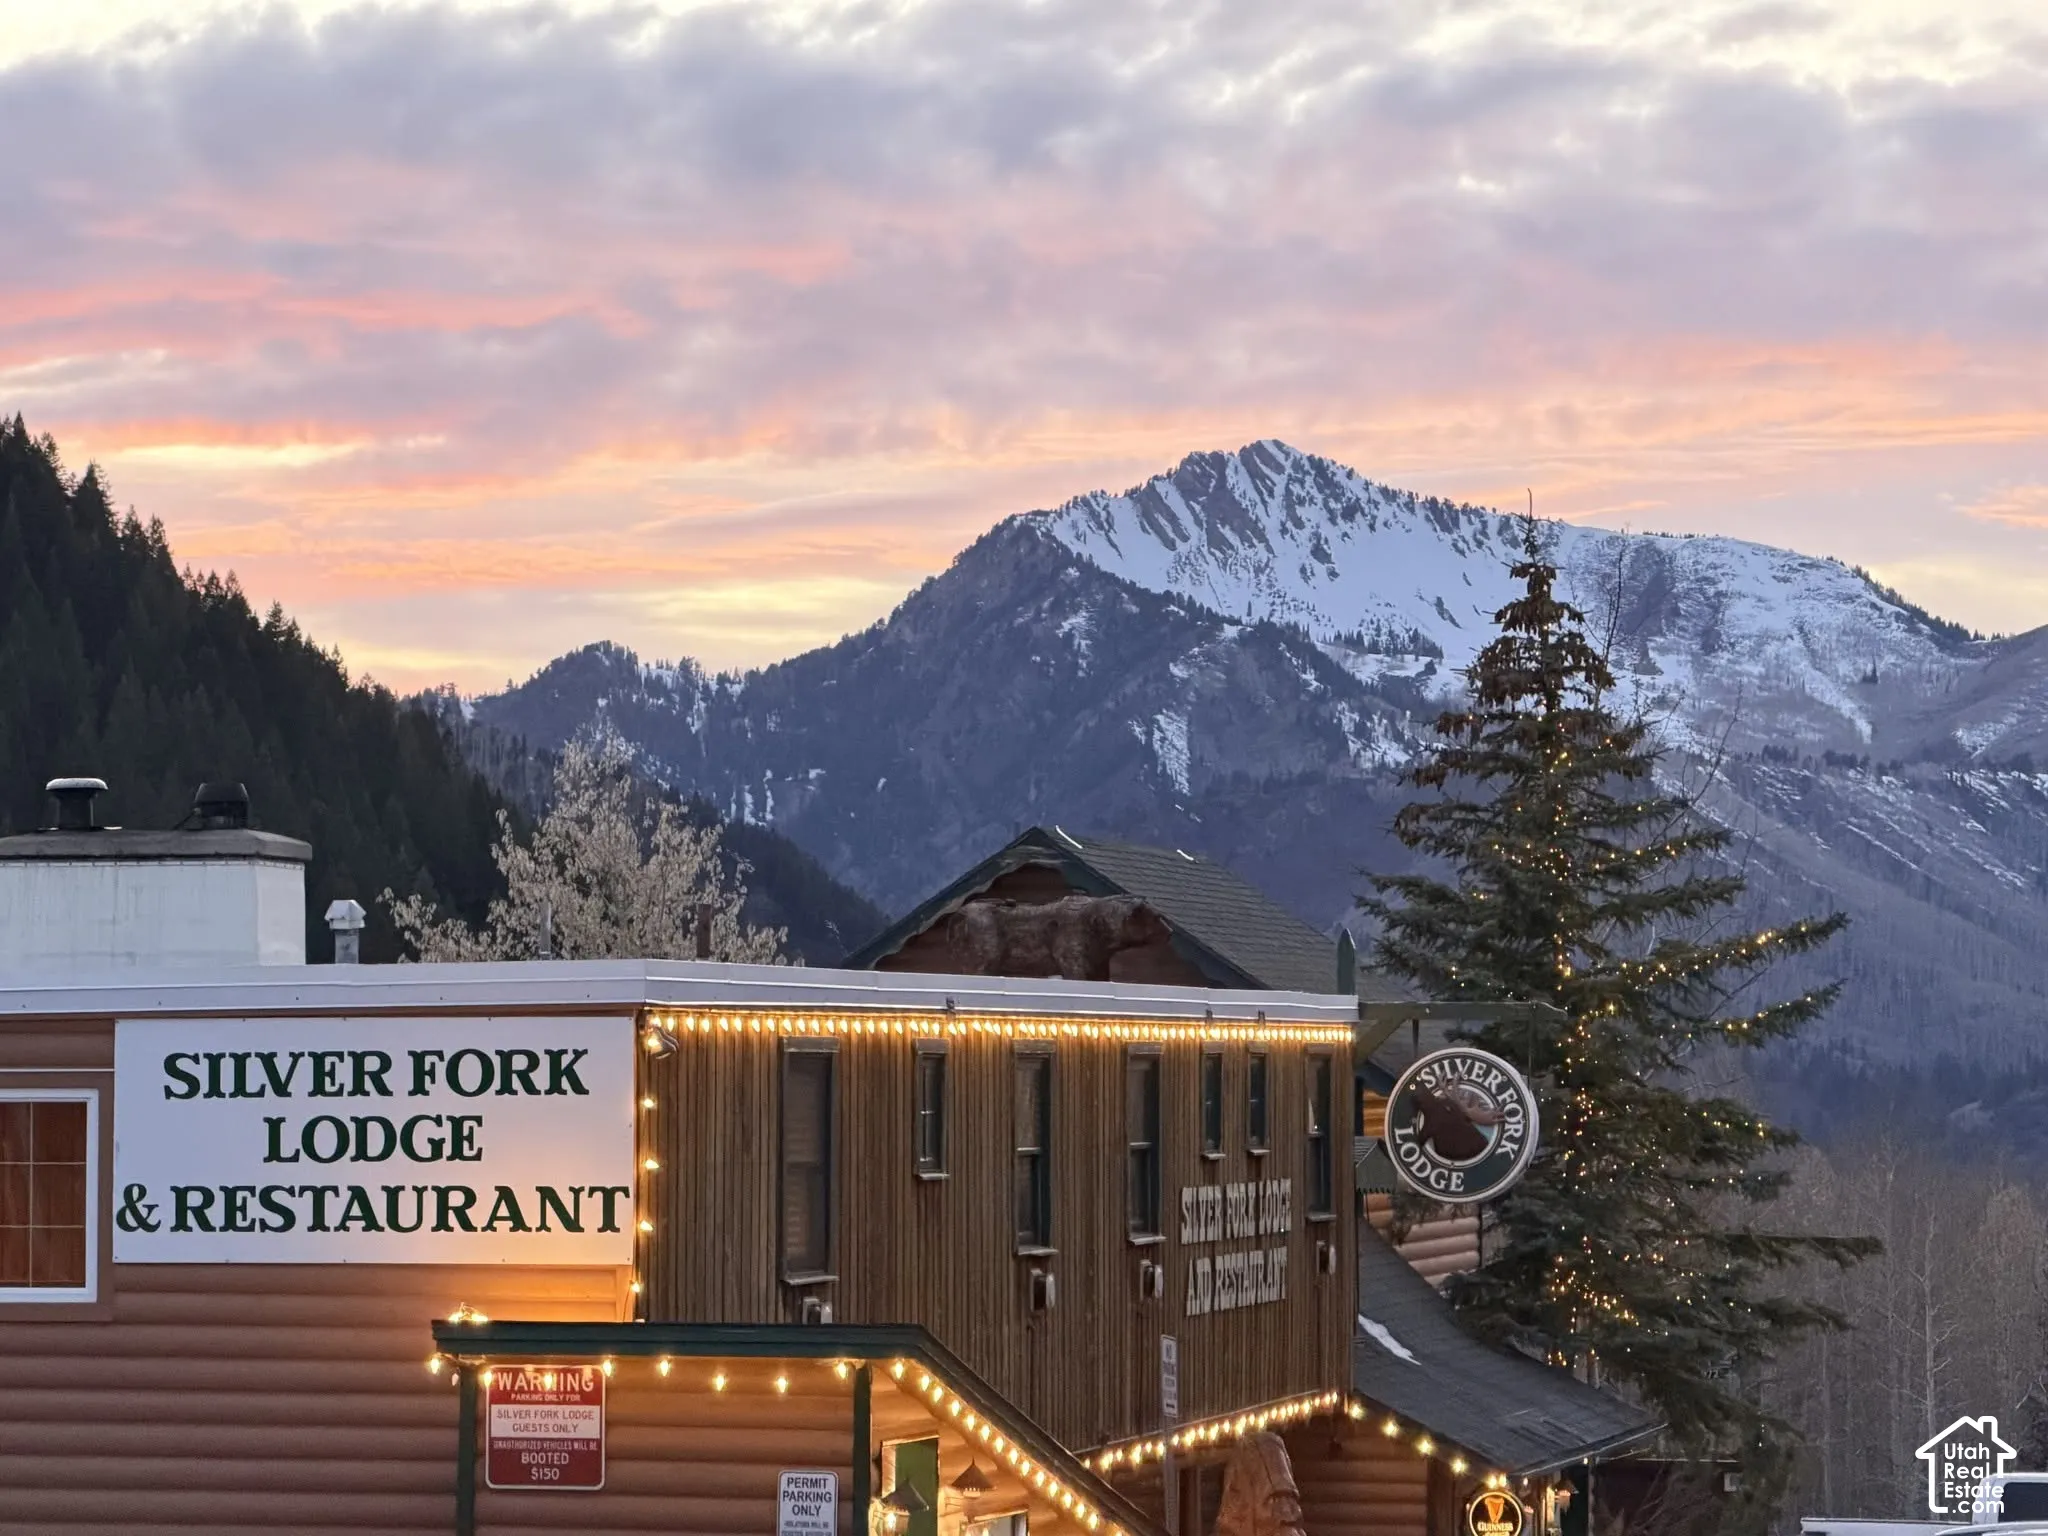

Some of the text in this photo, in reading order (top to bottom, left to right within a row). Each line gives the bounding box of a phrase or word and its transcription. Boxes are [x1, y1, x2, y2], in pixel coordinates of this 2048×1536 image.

[163, 1047, 590, 1100] SILVER FORK
[1419, 1057, 1525, 1161] SILVER FORK
[262, 1114, 483, 1163] LODGE
[1394, 1126, 1465, 1192] LODGE
[115, 1183, 631, 1234] & RESTAURANT
[1181, 1178, 1292, 1245] SILVER FORK LODGE
[1213, 1246, 1288, 1312] RESTAURANT
[497, 1372, 594, 1392] WARNING
[511, 1393, 543, 1401] PARKING
[496, 1409, 594, 1420] SILVER FORK LODGE
[512, 1423, 579, 1433] GUESTS ONLY
[521, 1452, 569, 1464] BOOTED
[531, 1467, 560, 1480] $150
[787, 1477, 829, 1489] PERMIT
[782, 1490, 832, 1503] PARKING
[792, 1504, 821, 1516] ONLY
[1477, 1521, 1513, 1531] GUINNESS
